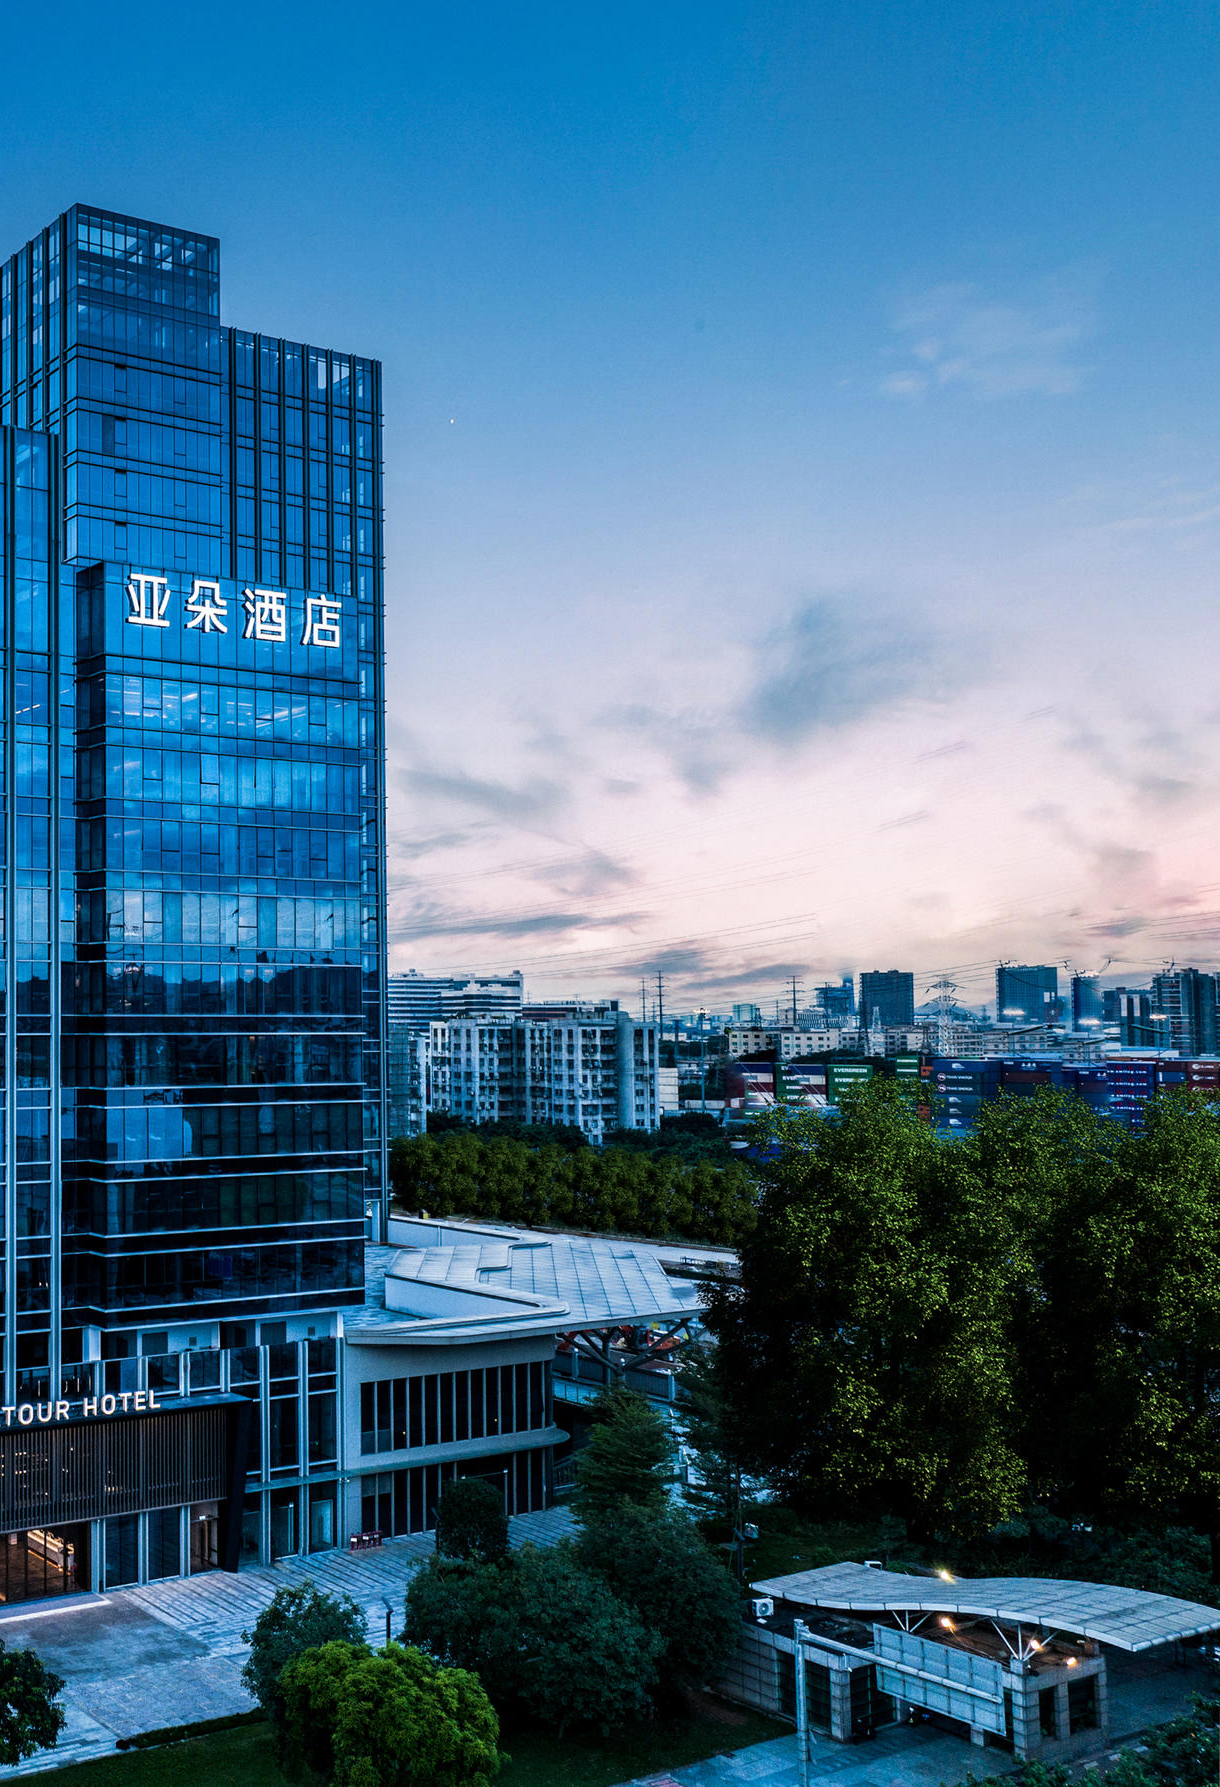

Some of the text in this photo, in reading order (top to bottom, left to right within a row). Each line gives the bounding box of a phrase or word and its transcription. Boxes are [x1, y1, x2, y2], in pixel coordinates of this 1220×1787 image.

[128, 573, 343, 648] 亚朵酒店
[83, 1389, 161, 1417] HOTEL
